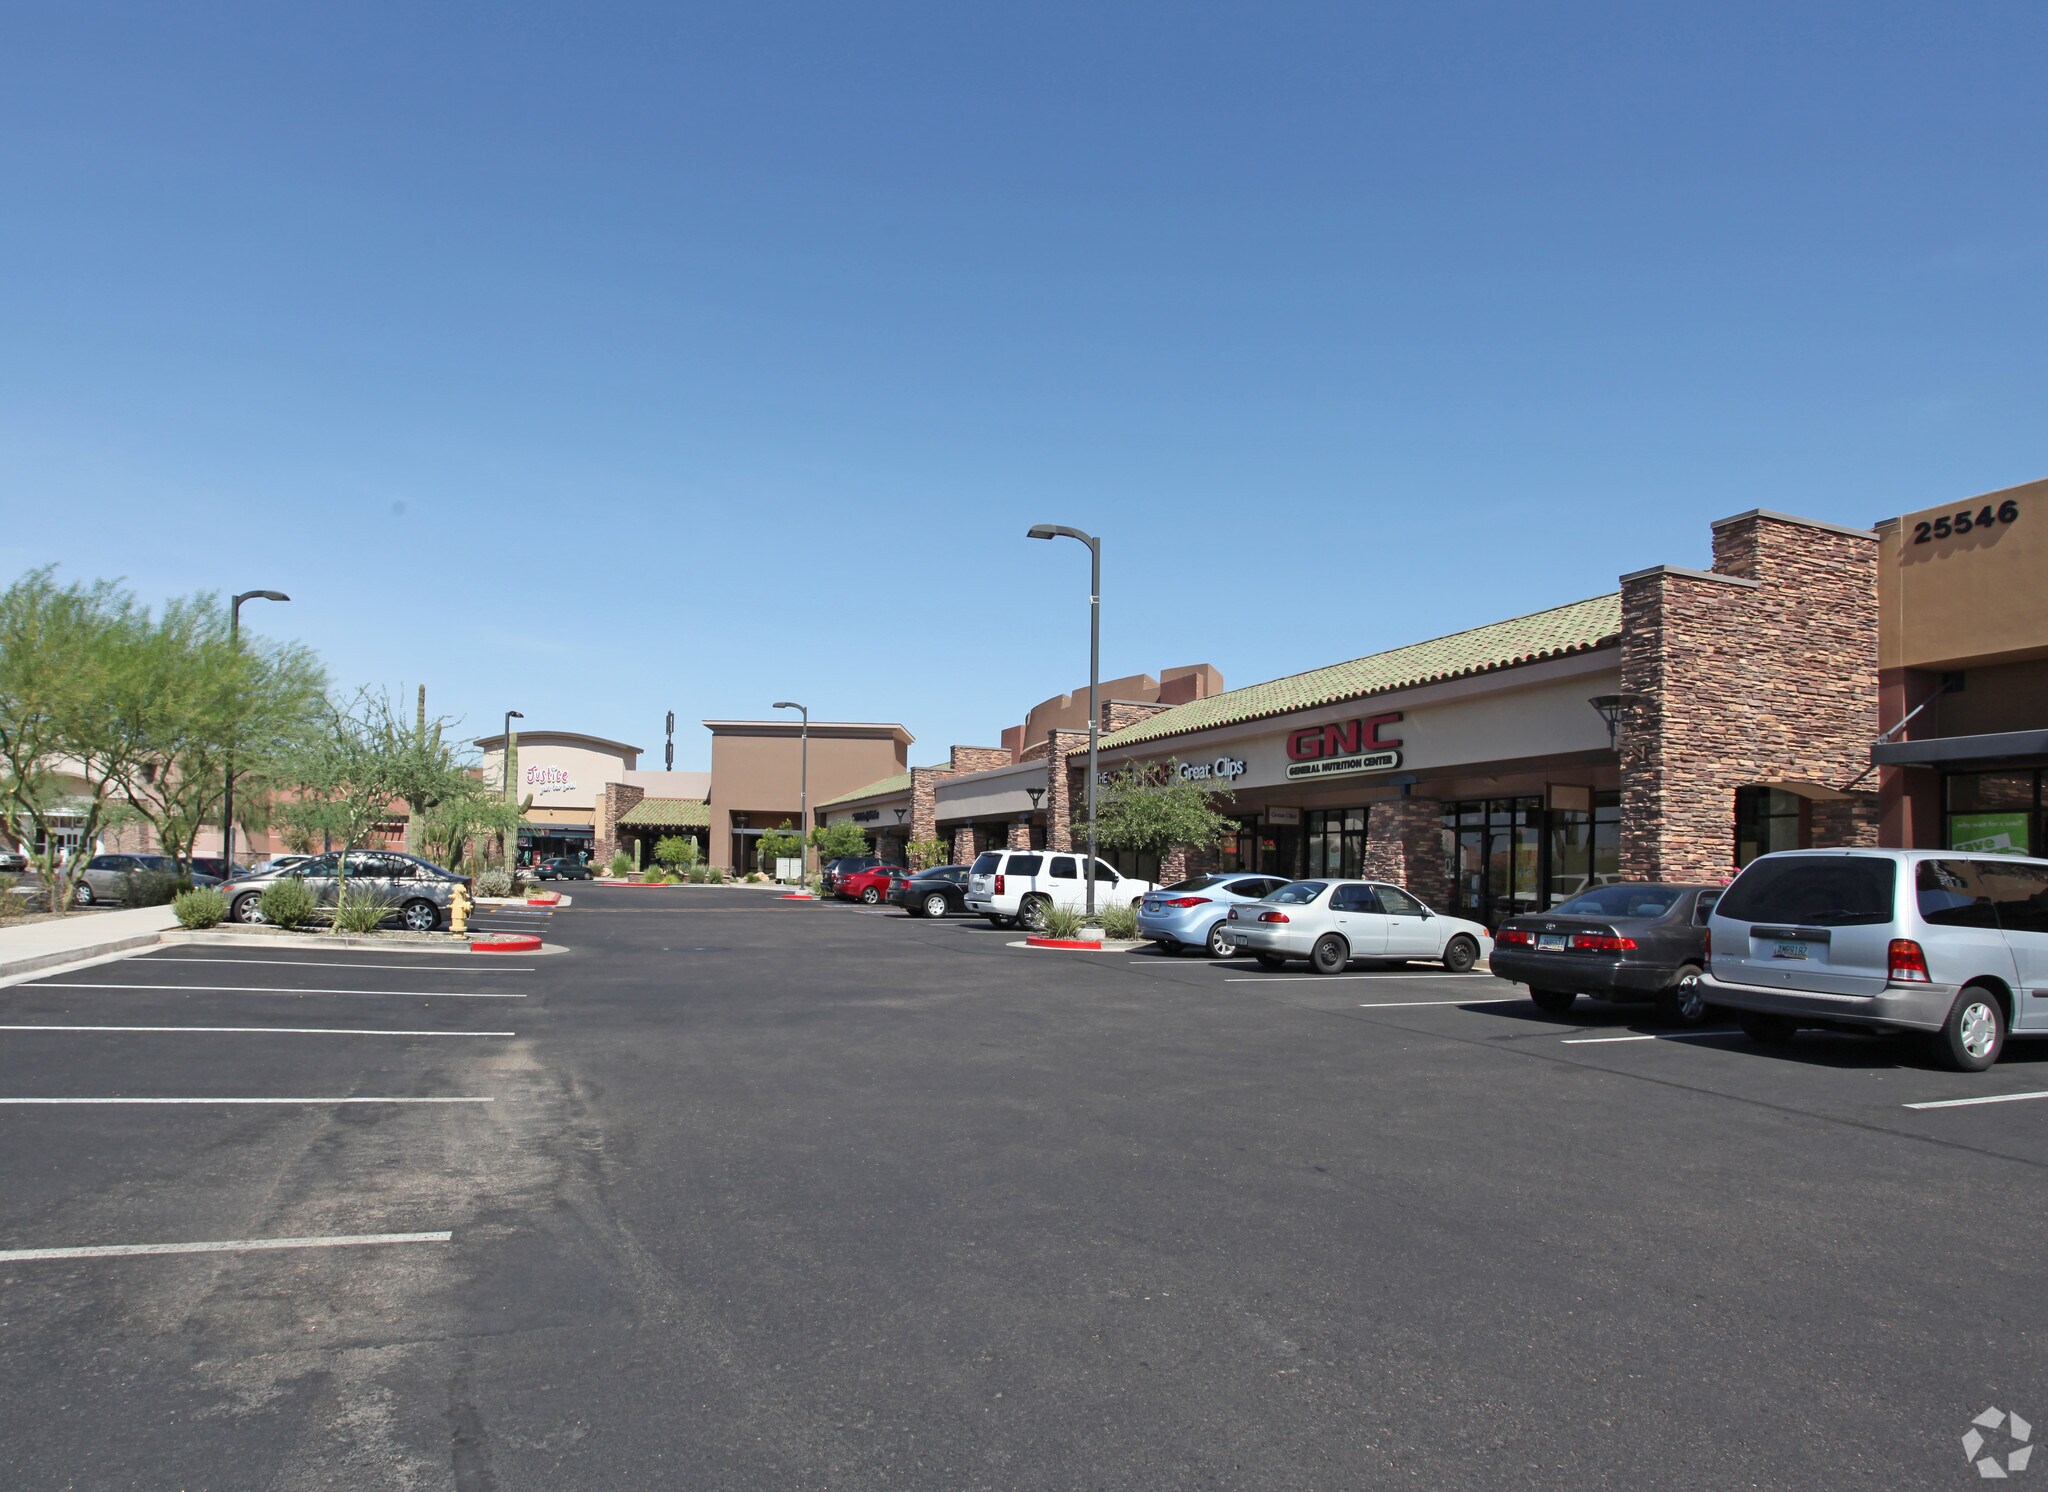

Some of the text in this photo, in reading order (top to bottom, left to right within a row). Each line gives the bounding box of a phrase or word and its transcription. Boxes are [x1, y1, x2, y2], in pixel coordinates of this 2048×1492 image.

[1914, 500, 2019, 545] 25546
[1286, 711, 1403, 761] GNC
[527, 765, 568, 784] Justice
[1179, 763, 1211, 780] Great
[1214, 757, 1247, 781] Clips
[1289, 755, 1393, 776] GENERAL NUTRITION CENTER
